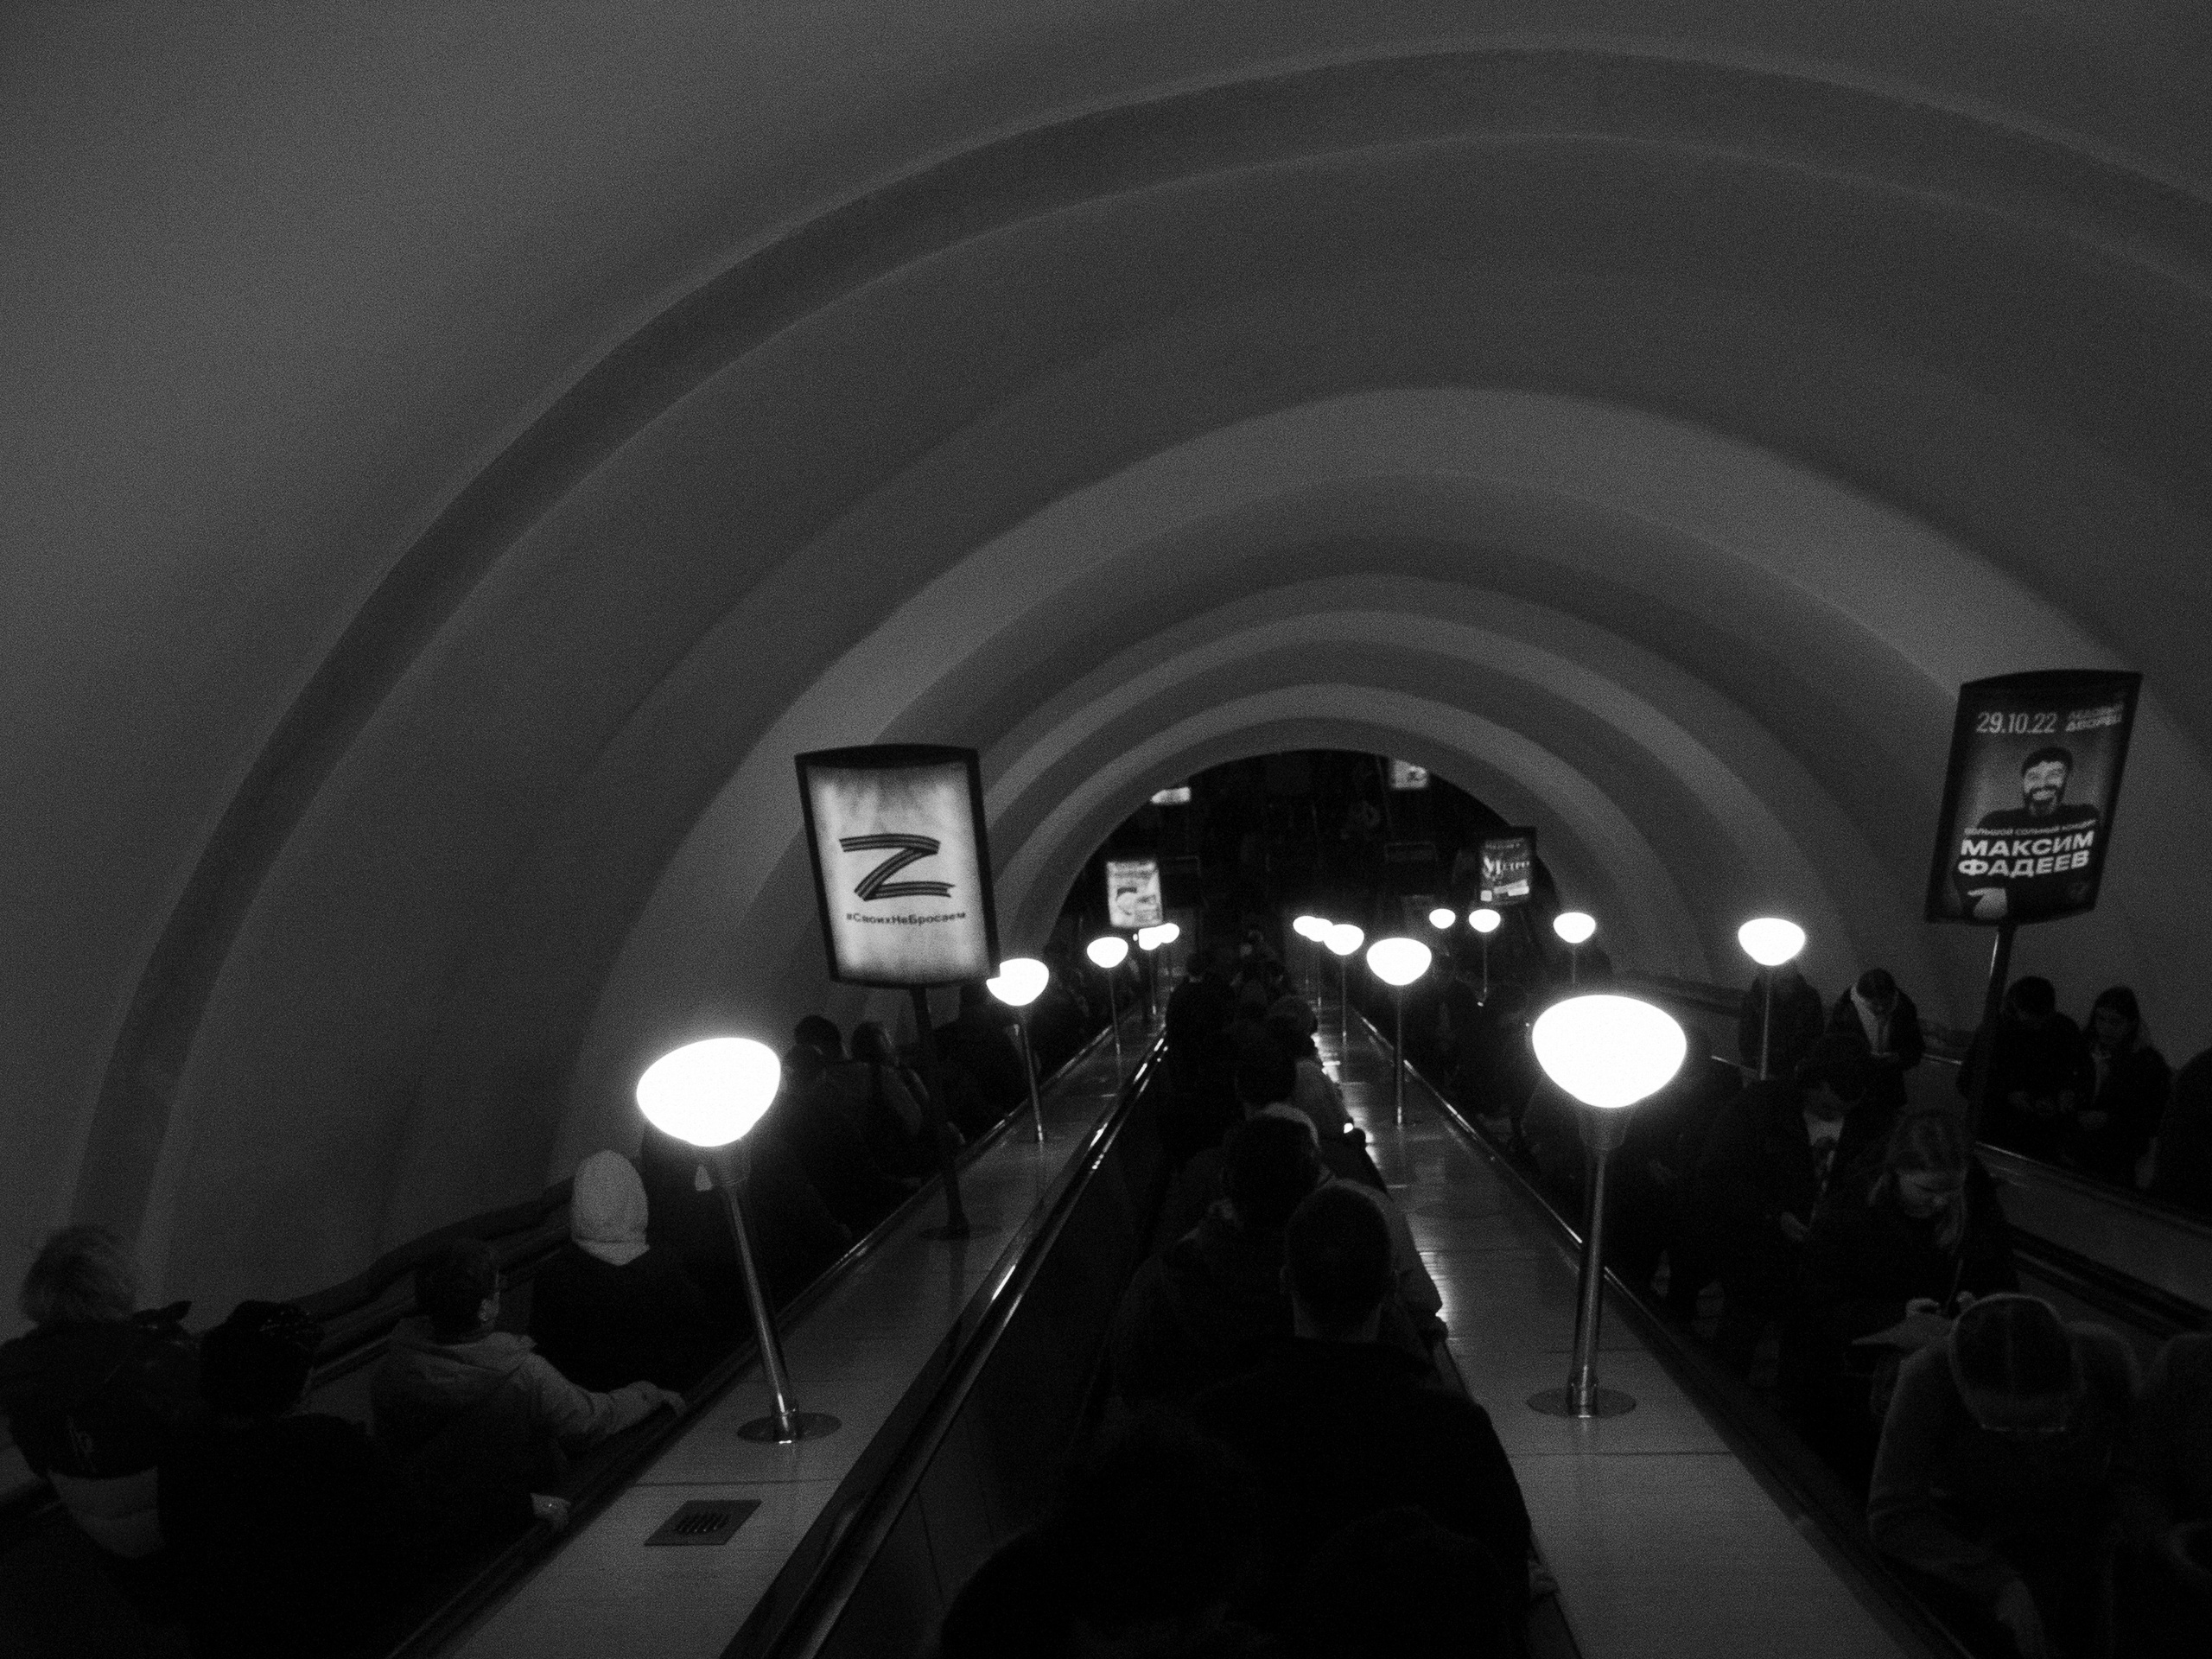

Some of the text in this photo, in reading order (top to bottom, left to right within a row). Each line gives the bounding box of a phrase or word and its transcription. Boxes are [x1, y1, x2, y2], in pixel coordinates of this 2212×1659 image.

[1976, 711, 2057, 734] 29.10.22
[1960, 830, 2094, 857] МАКСИМ
[839, 833, 956, 901] Z
[1957, 849, 2090, 879] ФАДЕЕВ
